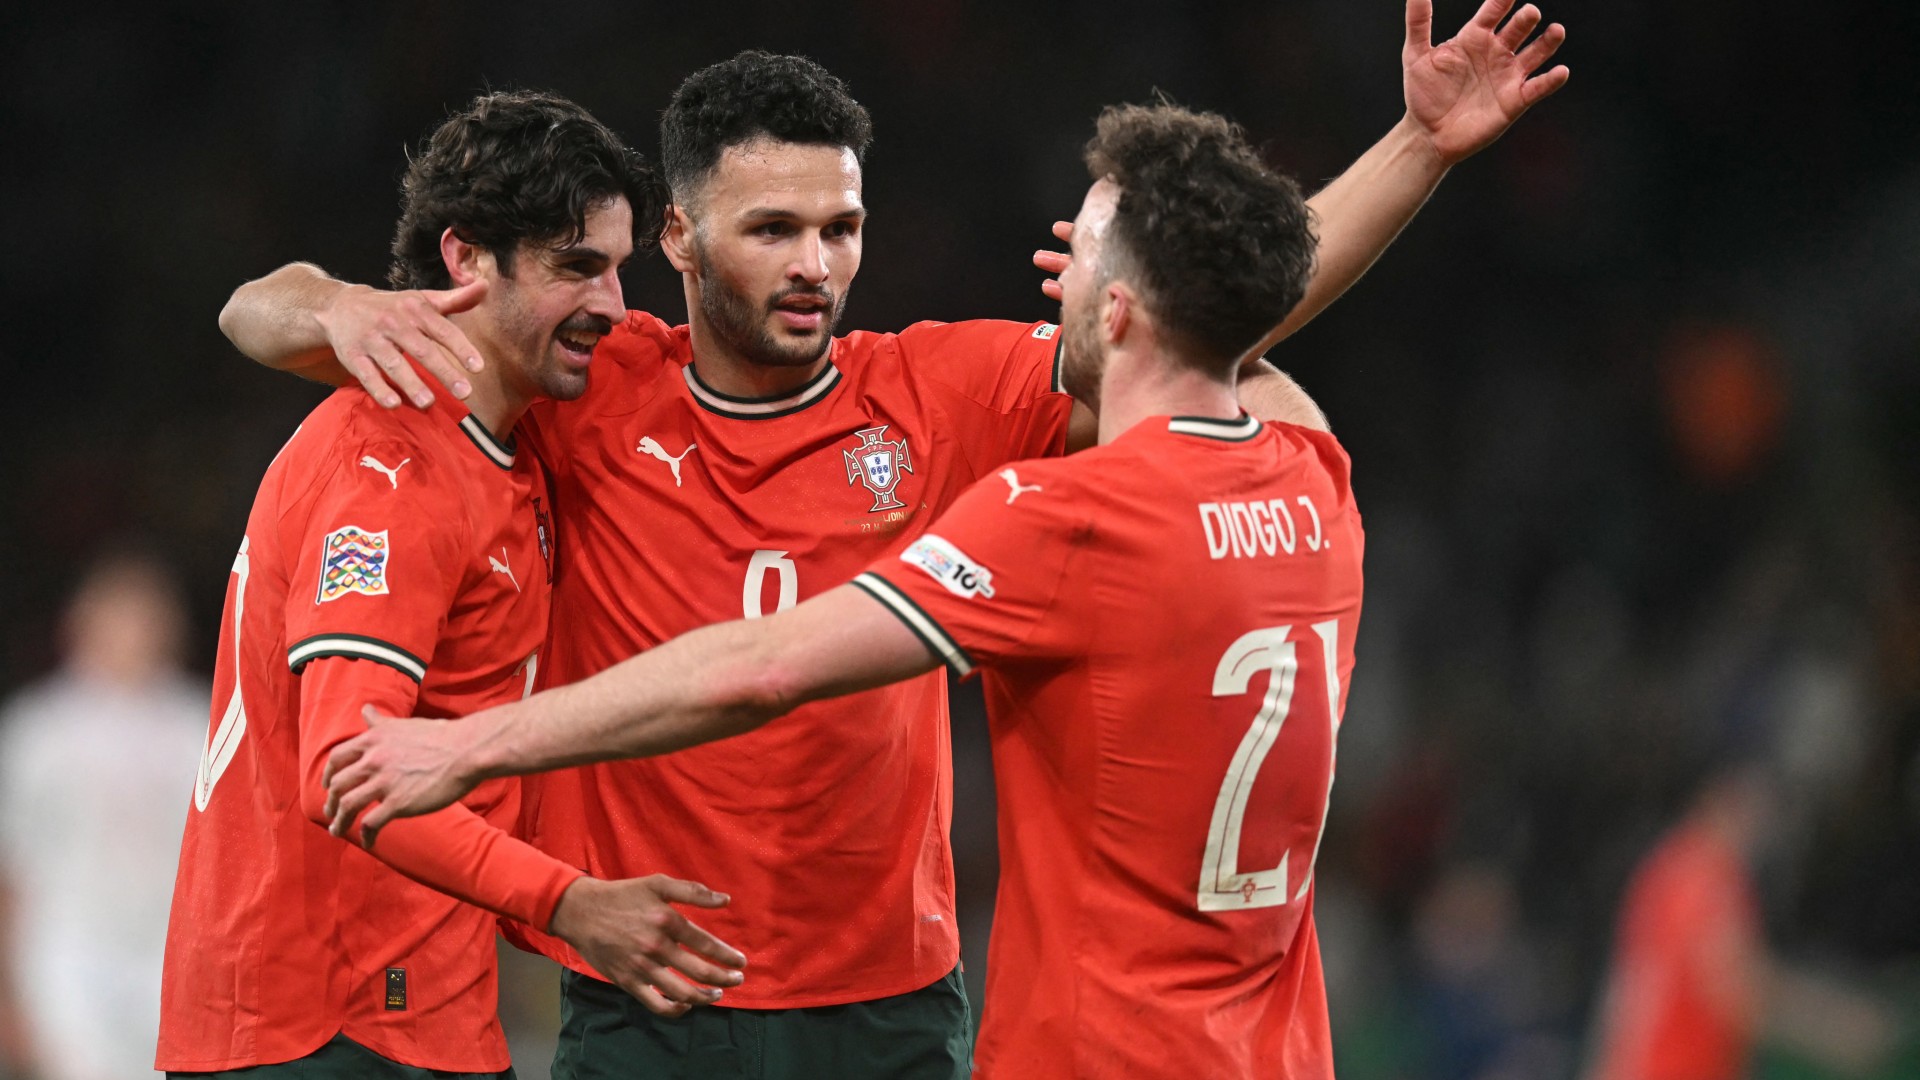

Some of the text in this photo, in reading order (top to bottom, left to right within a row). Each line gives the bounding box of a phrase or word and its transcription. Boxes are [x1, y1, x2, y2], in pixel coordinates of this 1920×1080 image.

[1198, 496, 1330, 559] DIOGO J.
[1198, 619, 1340, 911] 21
